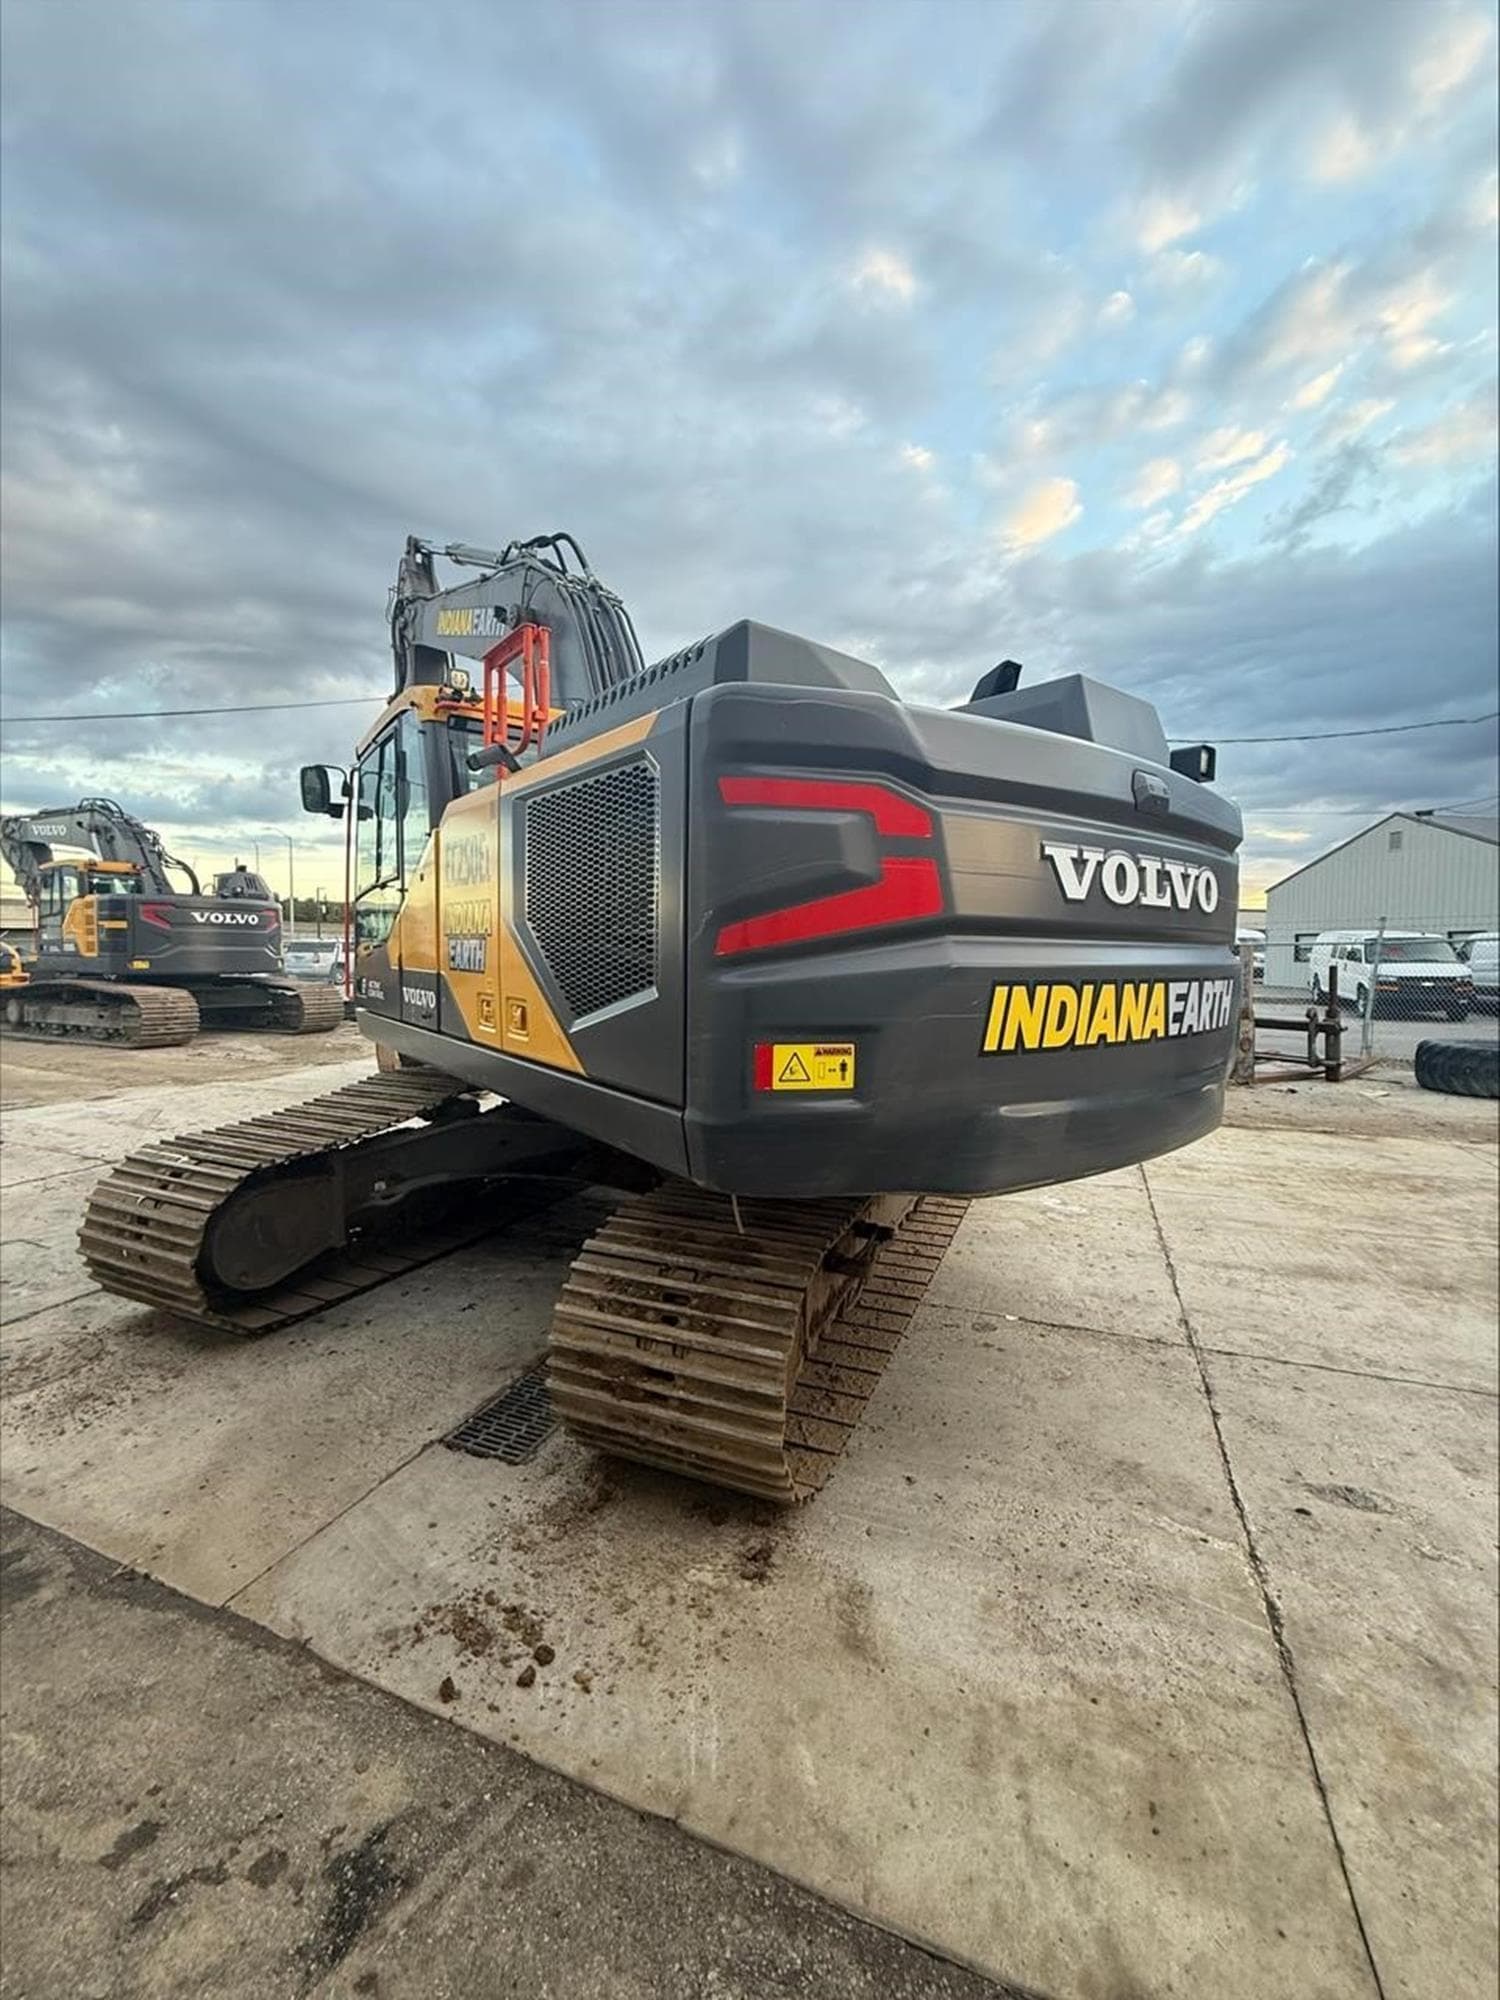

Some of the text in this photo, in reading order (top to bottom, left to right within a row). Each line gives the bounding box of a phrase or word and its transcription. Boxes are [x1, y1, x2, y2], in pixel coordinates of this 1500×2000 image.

[31, 824, 67, 836] VOLVO
[1041, 840, 1218, 913] VOLVO
[190, 911, 258, 926] VOLVO
[443, 900, 492, 935] INDIANA
[447, 937, 486, 972] EARTH
[402, 986, 436, 1009] VOLVO
